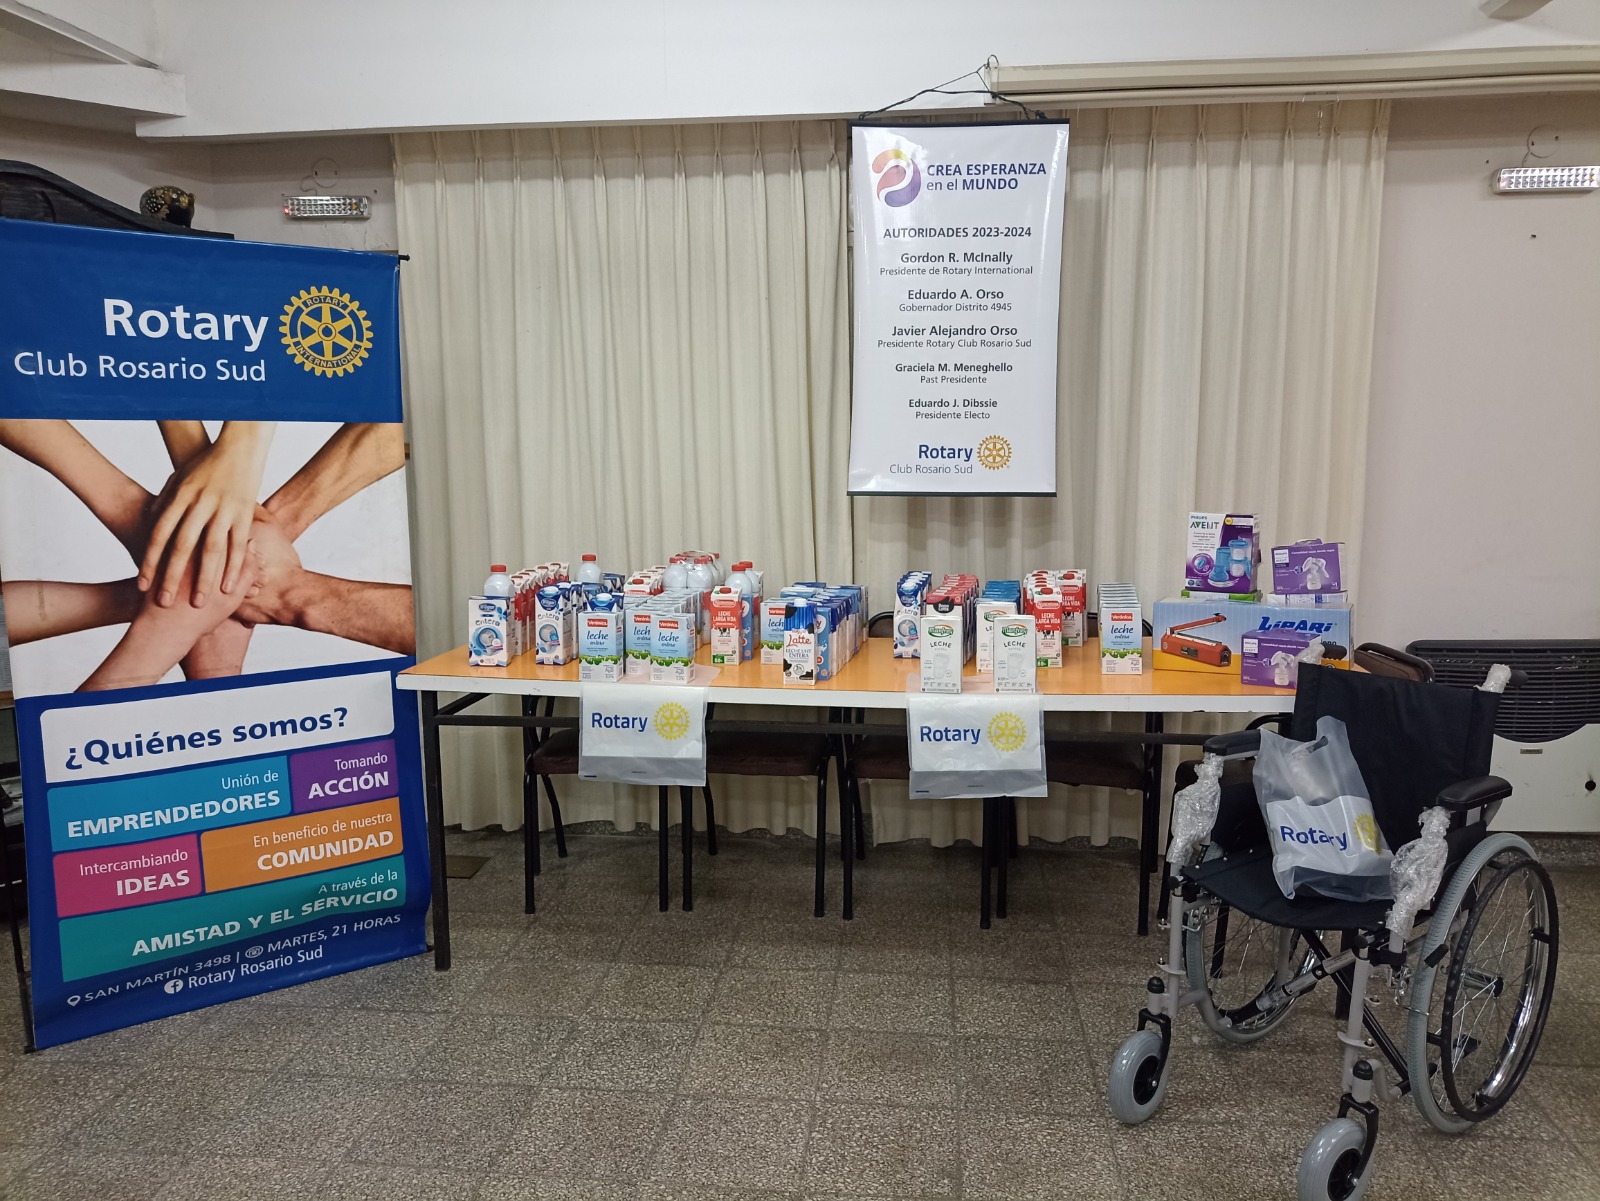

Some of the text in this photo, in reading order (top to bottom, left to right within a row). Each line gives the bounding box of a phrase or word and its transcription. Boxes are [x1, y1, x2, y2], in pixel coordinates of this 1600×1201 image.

[927, 163, 1046, 176] CREA ESPERANZA
[927, 178, 1018, 190] en el MUNDO
[884, 227, 1031, 238] AUTORIDADES 2023-2024
[901, 252, 1013, 265] Gordon R. McInally
[880, 266, 1033, 277] Presidente de Rotary International
[908, 289, 1004, 299] Eduardo A. Orso
[306, 296, 345, 308] ROTARY
[899, 303, 1012, 312] Gobernador Distrito 4945
[104, 298, 269, 352] Rotary
[892, 325, 1017, 338] Javier Alejandro Orso
[878, 339, 1031, 349] Presidente Rotary Club Rosario Sud
[296, 344, 361, 368] INTERNATIONAL
[14, 352, 266, 382] Club Rosario Sud
[896, 363, 1013, 374] Graciela M. Meneghello
[909, 399, 998, 408] Eduardo J. Dibssie
[965, 411, 990, 419] Electo
[918, 444, 973, 462] Rotary
[890, 464, 973, 473] Club Rosario Sud
[768, 619, 784, 627] lech
[1111, 624, 1133, 634] leche
[587, 630, 608, 640] leche
[634, 626, 650, 636] lech
[658, 632, 679, 642] leche
[786, 634, 811, 647] Latte
[590, 712, 648, 732] Rotary
[65, 707, 349, 770] ¿Quiénes somos?
[919, 725, 981, 745] Rotary
[334, 752, 388, 771] Tomando
[221, 770, 279, 791] Unión de
[308, 771, 389, 799] ACCIÓN
[67, 791, 281, 838] EMPRENDEDORES
[253, 812, 392, 848] En beneficio de nuestra
[1280, 825, 1348, 852] Rotary
[257, 831, 394, 871] COMUNIDAD
[79, 849, 188, 876] Intercambiando
[116, 870, 190, 896] IDEAS
[319, 870, 398, 894] A través de la
[132, 888, 398, 956] AMISTAD Y EL SERVICIO
[84, 985, 119, 1003] SAN
[126, 964, 190, 991] MARTÍN
[195, 953, 231, 972] 3498
[267, 930, 327, 953] MARTES,
[332, 925, 348, 937] 21
[354, 914, 402, 932] HORAS
[188, 946, 323, 989] Rotary Rosario Sud
